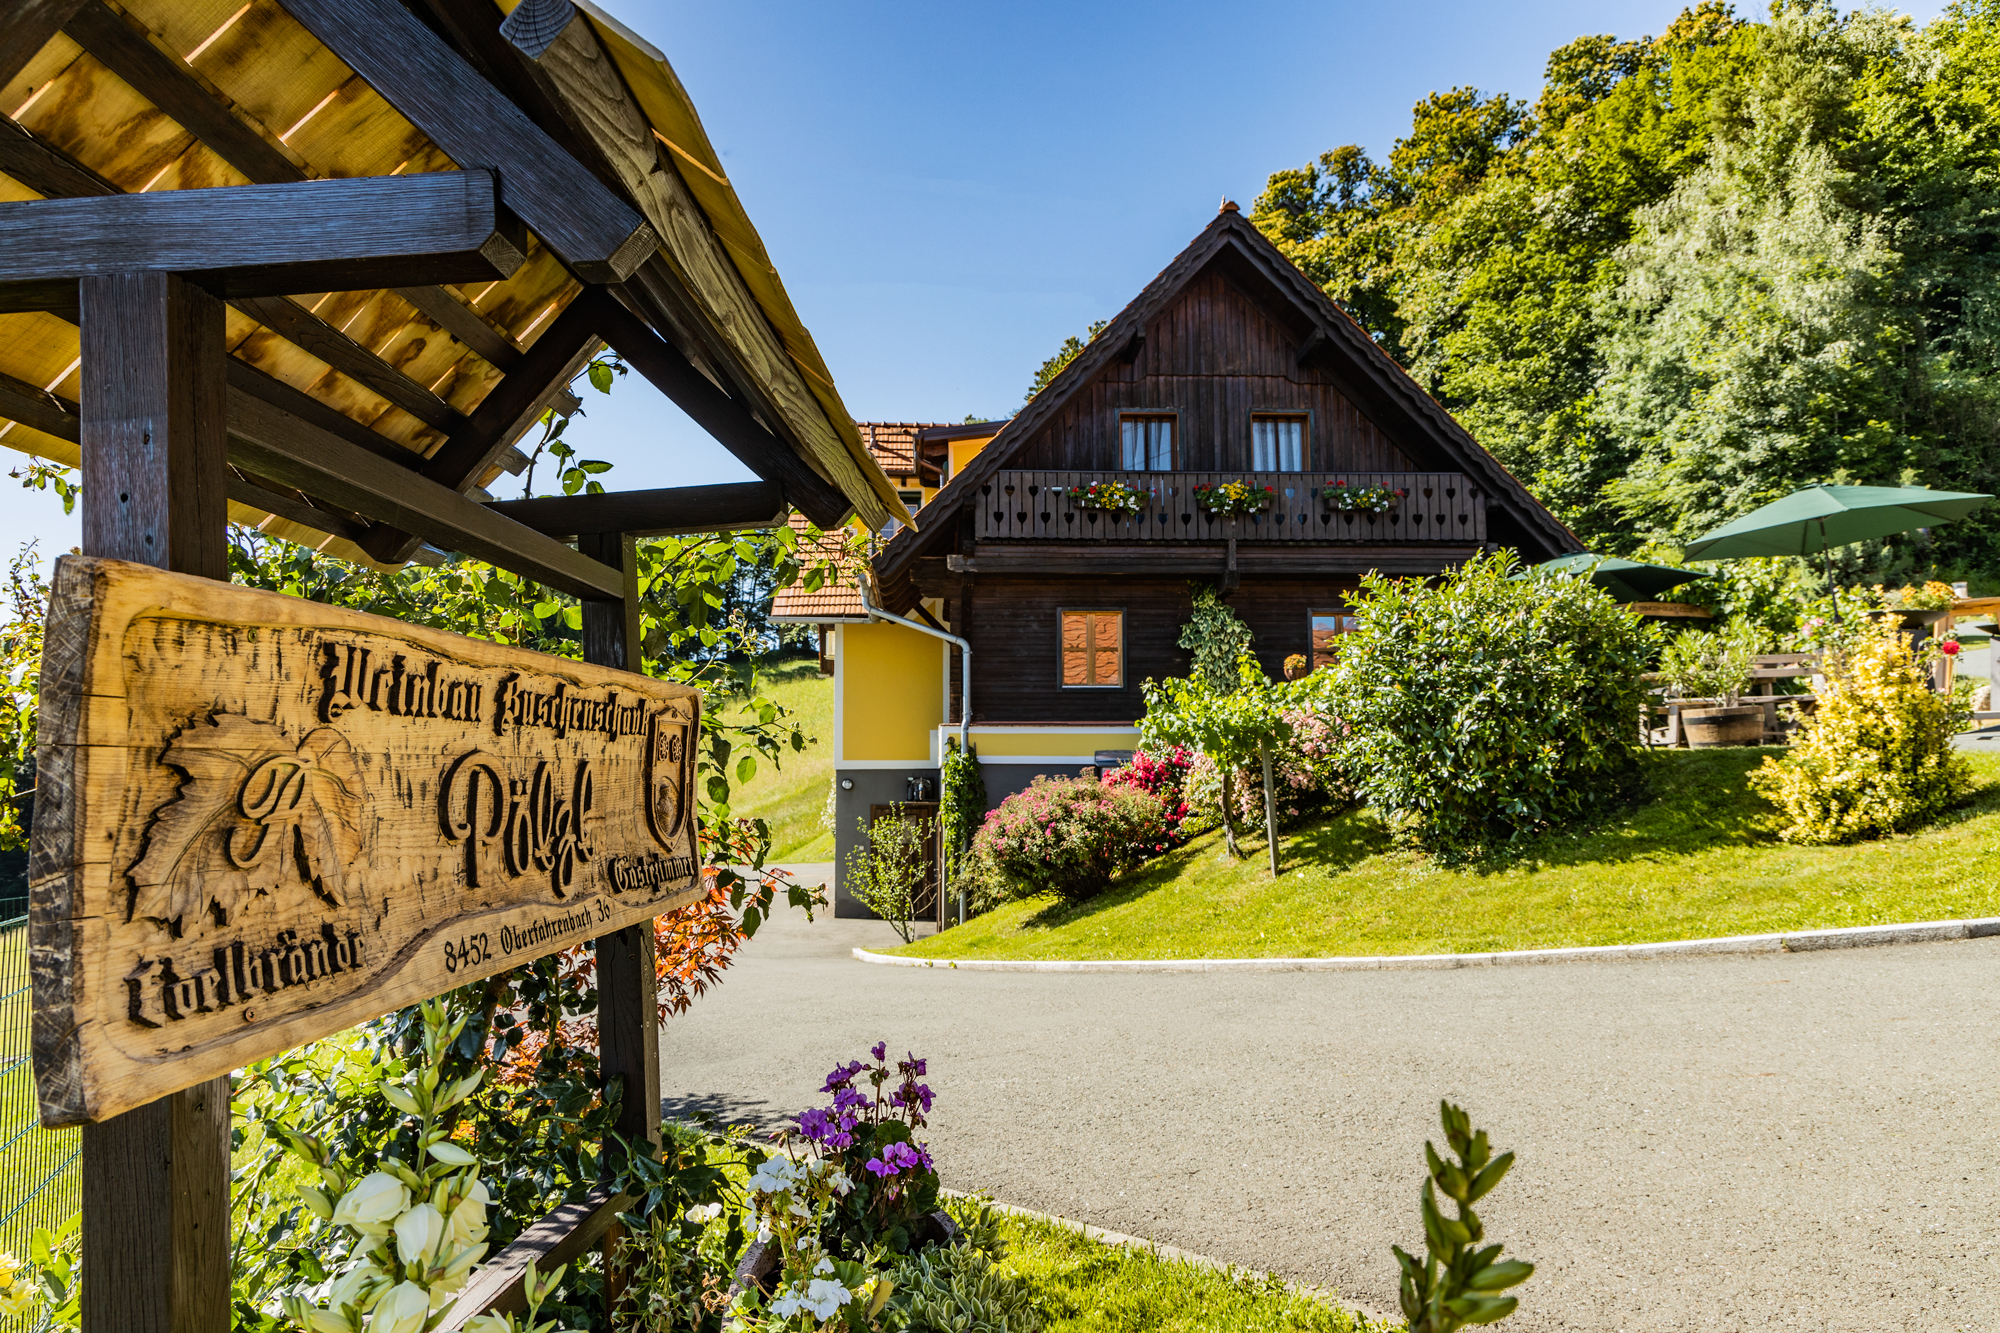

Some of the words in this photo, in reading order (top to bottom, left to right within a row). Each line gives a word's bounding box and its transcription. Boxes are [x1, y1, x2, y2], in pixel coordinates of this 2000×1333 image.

[317, 641, 484, 723] Weinbau
[493, 672, 650, 742] Buschenschank
[438, 749, 594, 901] Pölzl
[123, 923, 365, 1028] Edelbrände
[444, 931, 492, 973] 8452
[500, 904, 593, 955] Oberfahrenbach
[596, 897, 611, 922] 36
